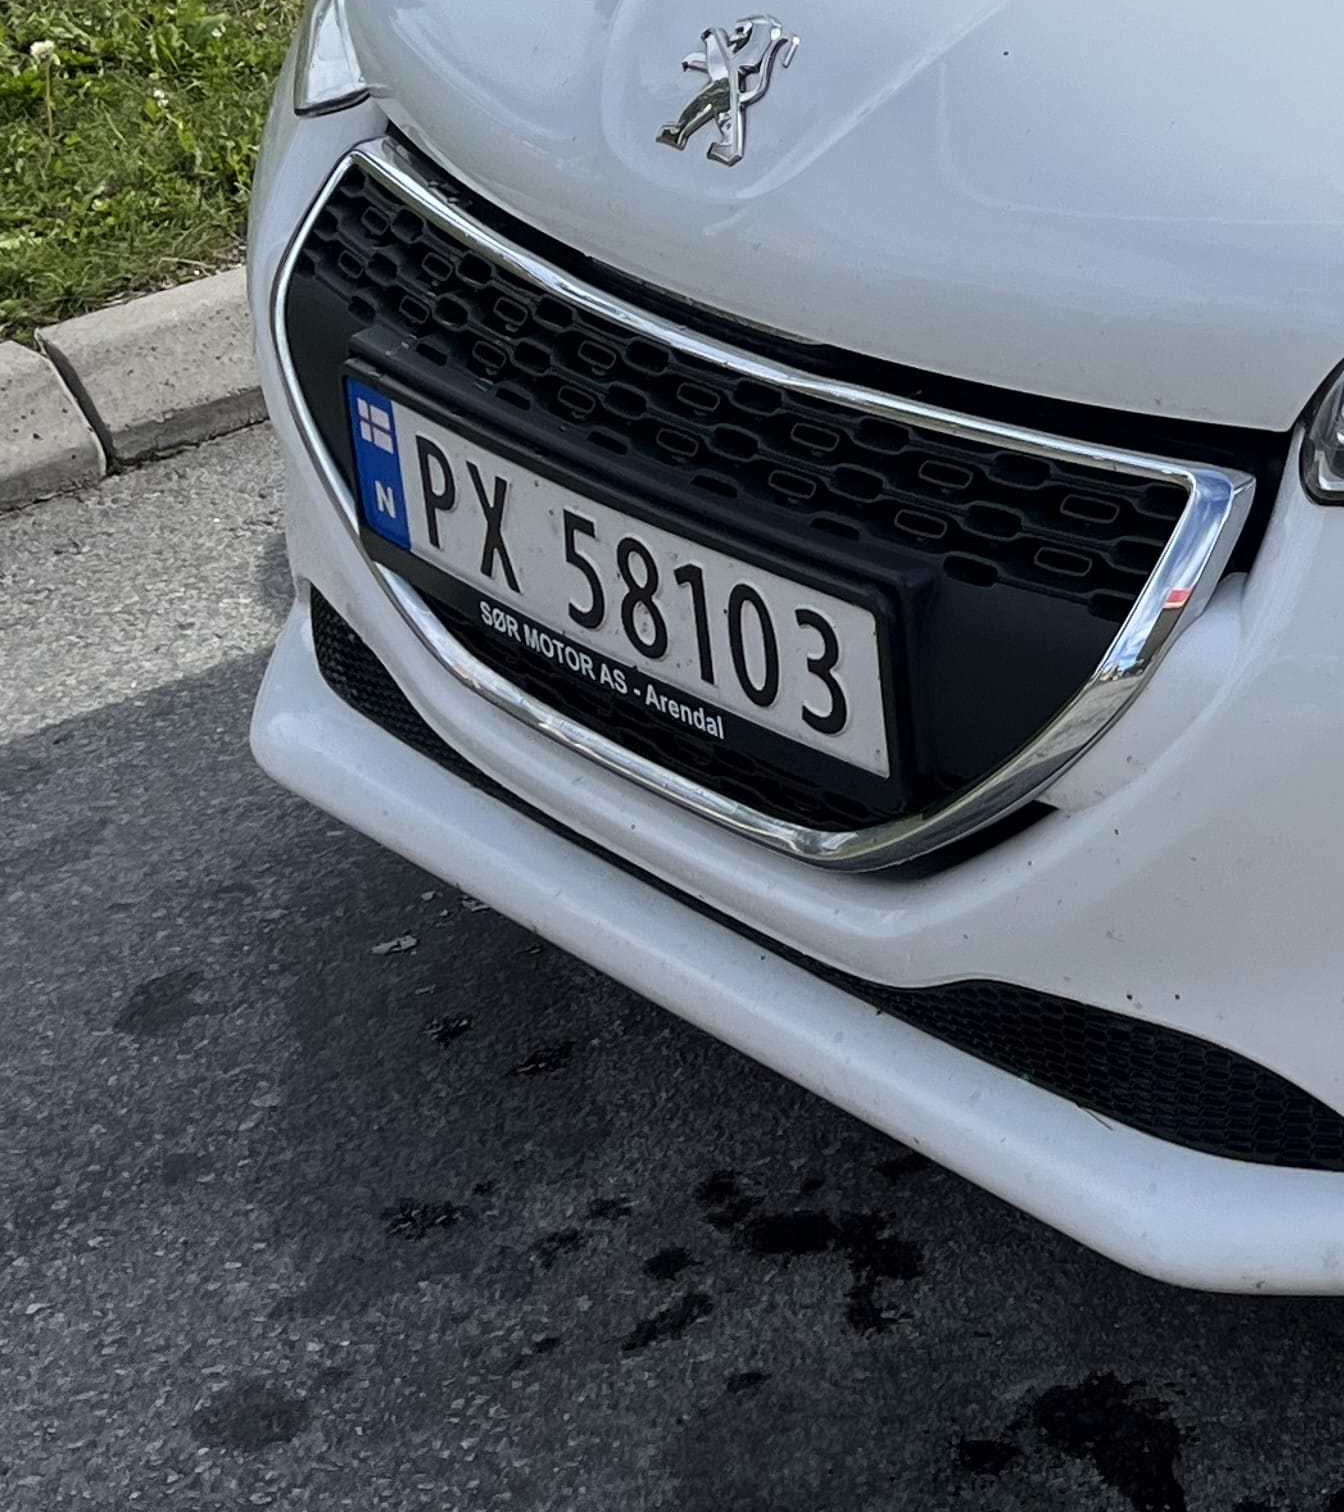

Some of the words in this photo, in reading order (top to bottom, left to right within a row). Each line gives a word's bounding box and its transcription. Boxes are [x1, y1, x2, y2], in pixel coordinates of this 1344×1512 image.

[375, 480, 396, 518] N
[415, 434, 521, 593] PX
[563, 508, 848, 735] 58103
[479, 601, 521, 642] SØR
[523, 623, 596, 680] MOTOR
[600, 663, 628, 694] AS
[645, 684, 725, 739] Arendal
